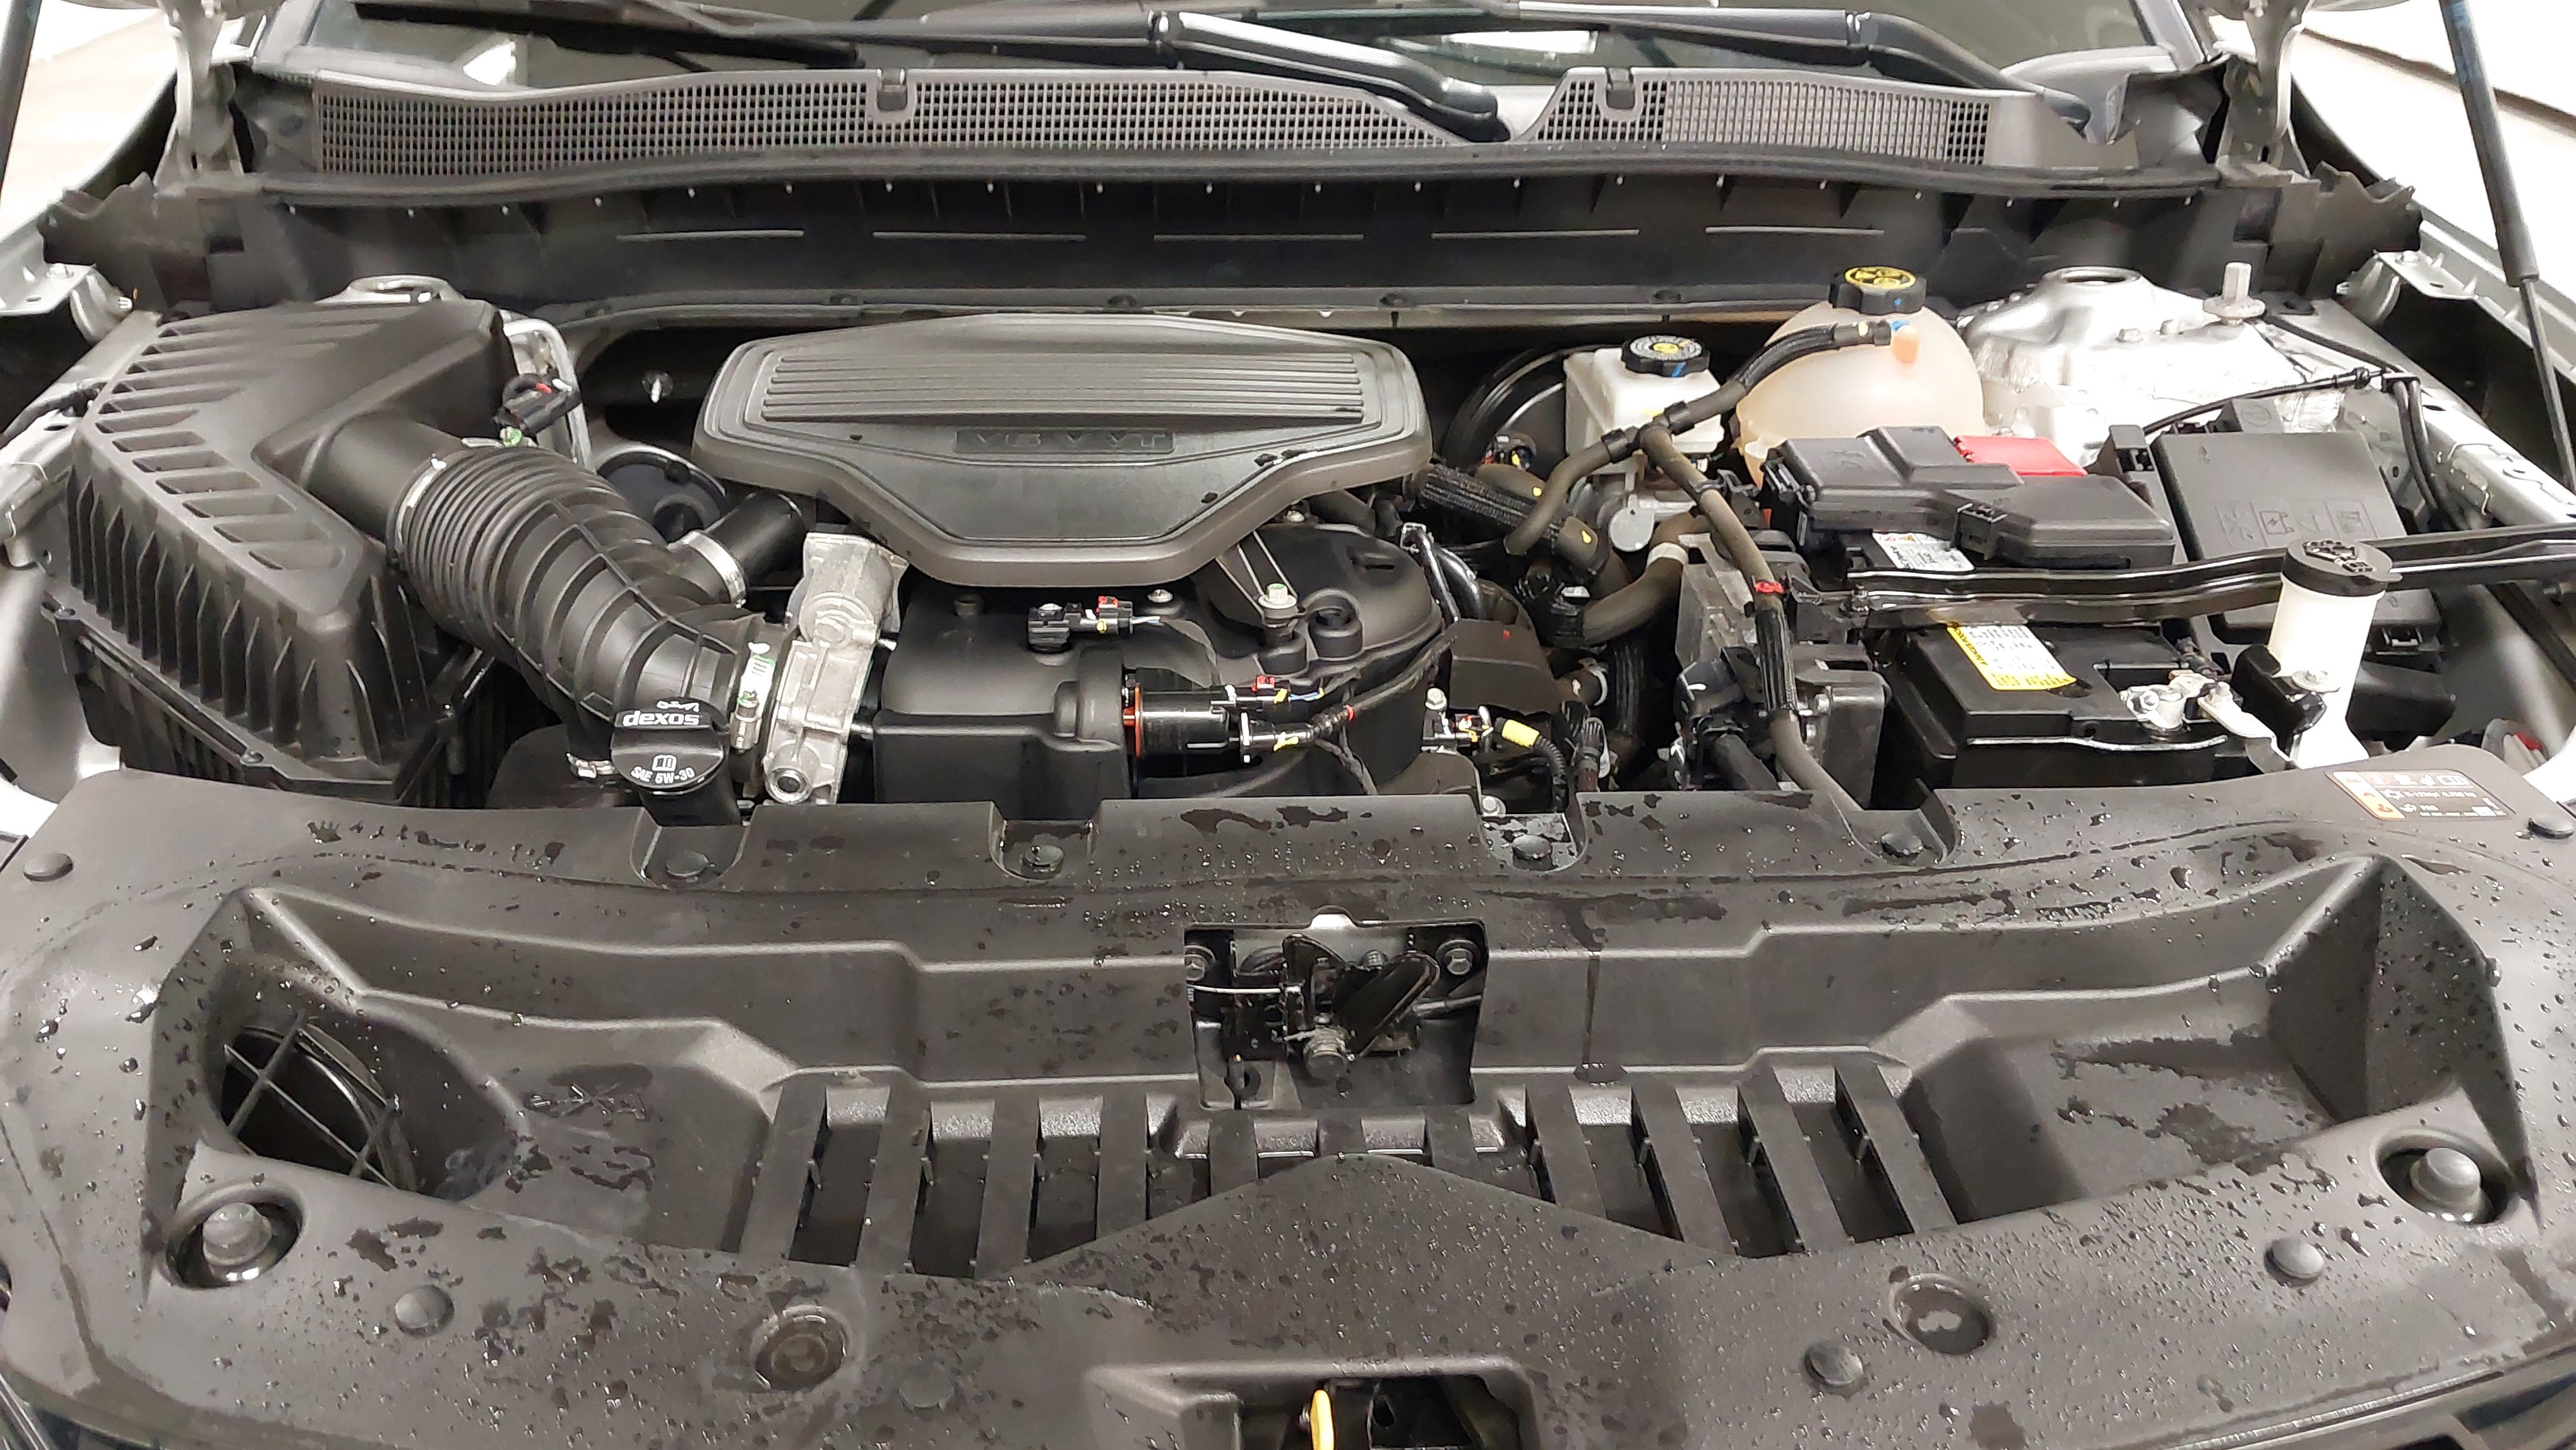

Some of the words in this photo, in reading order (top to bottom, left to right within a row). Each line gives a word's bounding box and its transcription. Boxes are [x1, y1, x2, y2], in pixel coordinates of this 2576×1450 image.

[623, 710, 700, 726] dexos
[631, 766, 652, 782] SAE
[655, 767, 695, 784] 5W-30
